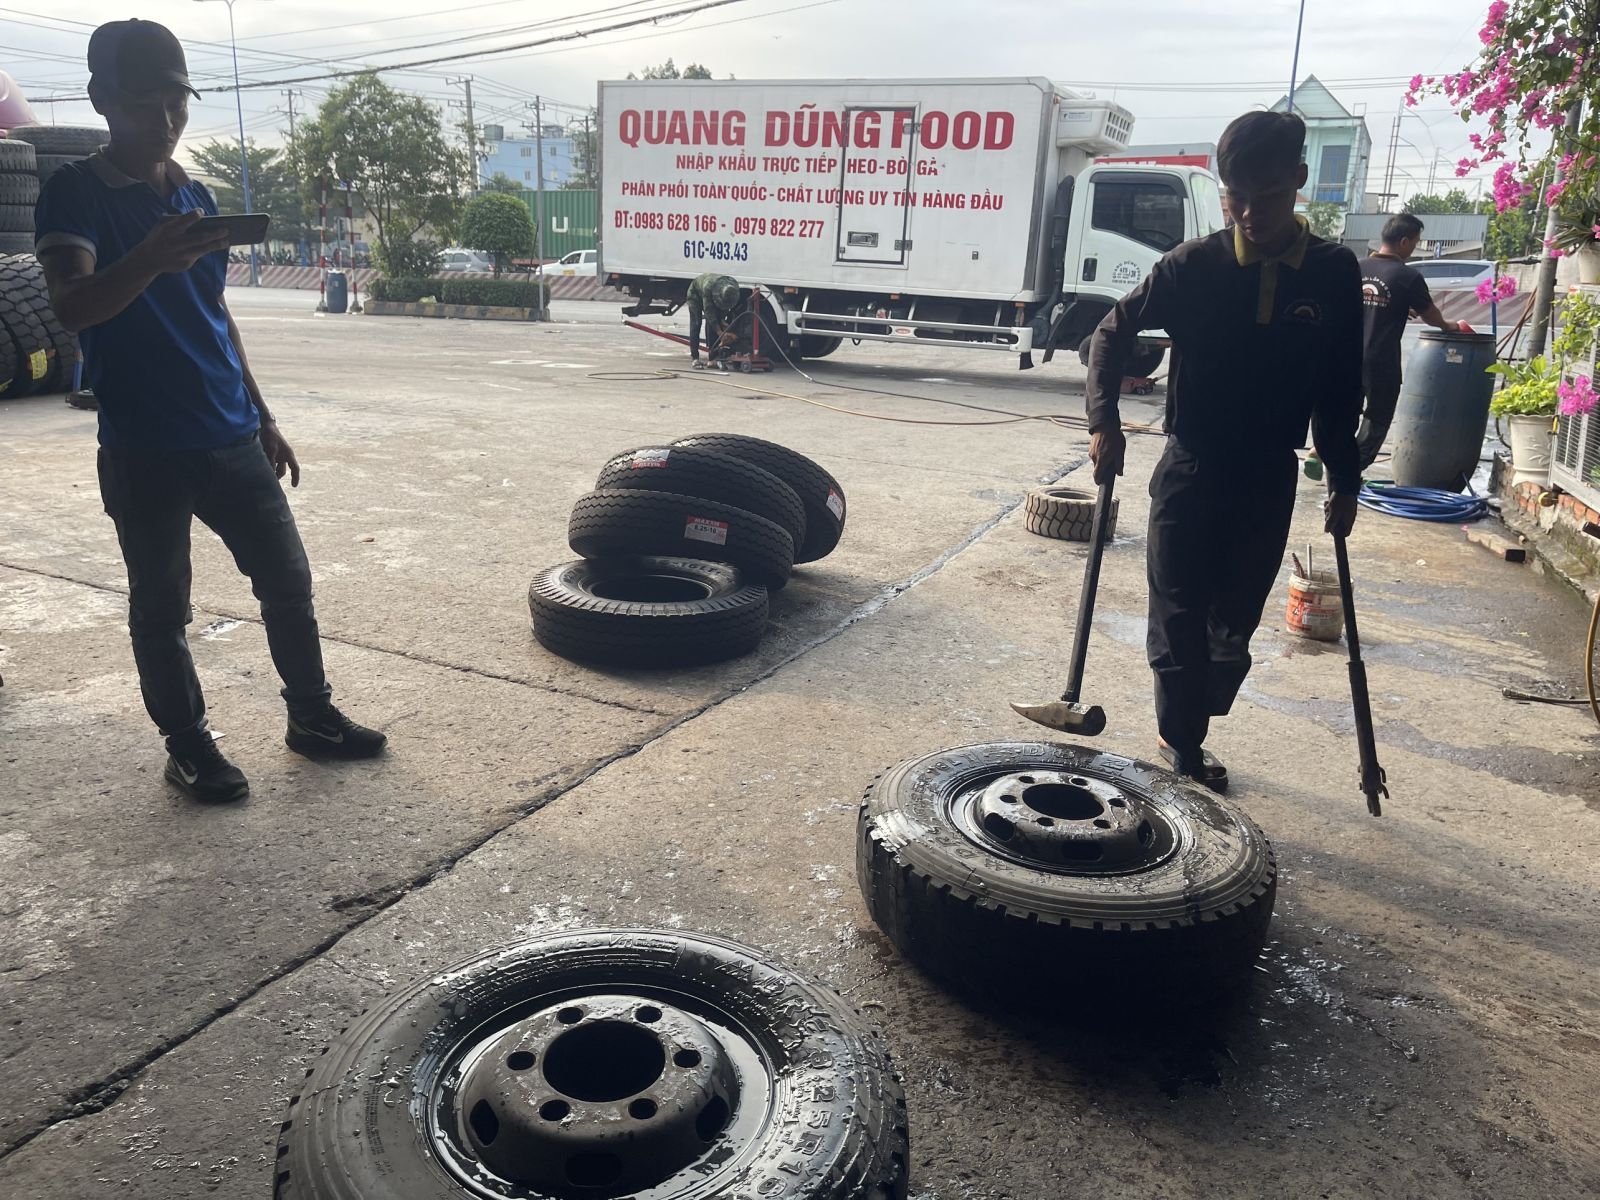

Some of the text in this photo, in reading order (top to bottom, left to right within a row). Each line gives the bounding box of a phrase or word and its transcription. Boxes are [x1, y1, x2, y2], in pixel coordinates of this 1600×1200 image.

[619, 103, 1015, 150] QUANG DŨNG FOOD
[676, 152, 714, 173] NHẬP
[718, 149, 757, 172] KHẨU
[762, 156, 800, 176] TRỰC
[805, 152, 838, 174] TIẾP
[621, 180, 656, 197] PHÂN
[659, 179, 689, 199] PHỐI
[692, 182, 727, 200] TOÀN
[730, 180, 767, 201] QUỐC
[777, 182, 813, 204] CHẤT
[817, 187, 865, 208] LƯỢNG
[869, 190, 889, 206] UY
[893, 188, 917, 208] TÍN
[922, 189, 966, 209] HÀNG
[970, 188, 1004, 211] ĐẦU
[667, 213, 690, 231] 628
[694, 215, 717, 233] 166
[734, 217, 766, 236] 0979
[770, 219, 795, 237] 822
[798, 220, 825, 239] 277
[683, 240, 748, 262] 61C-493.43
